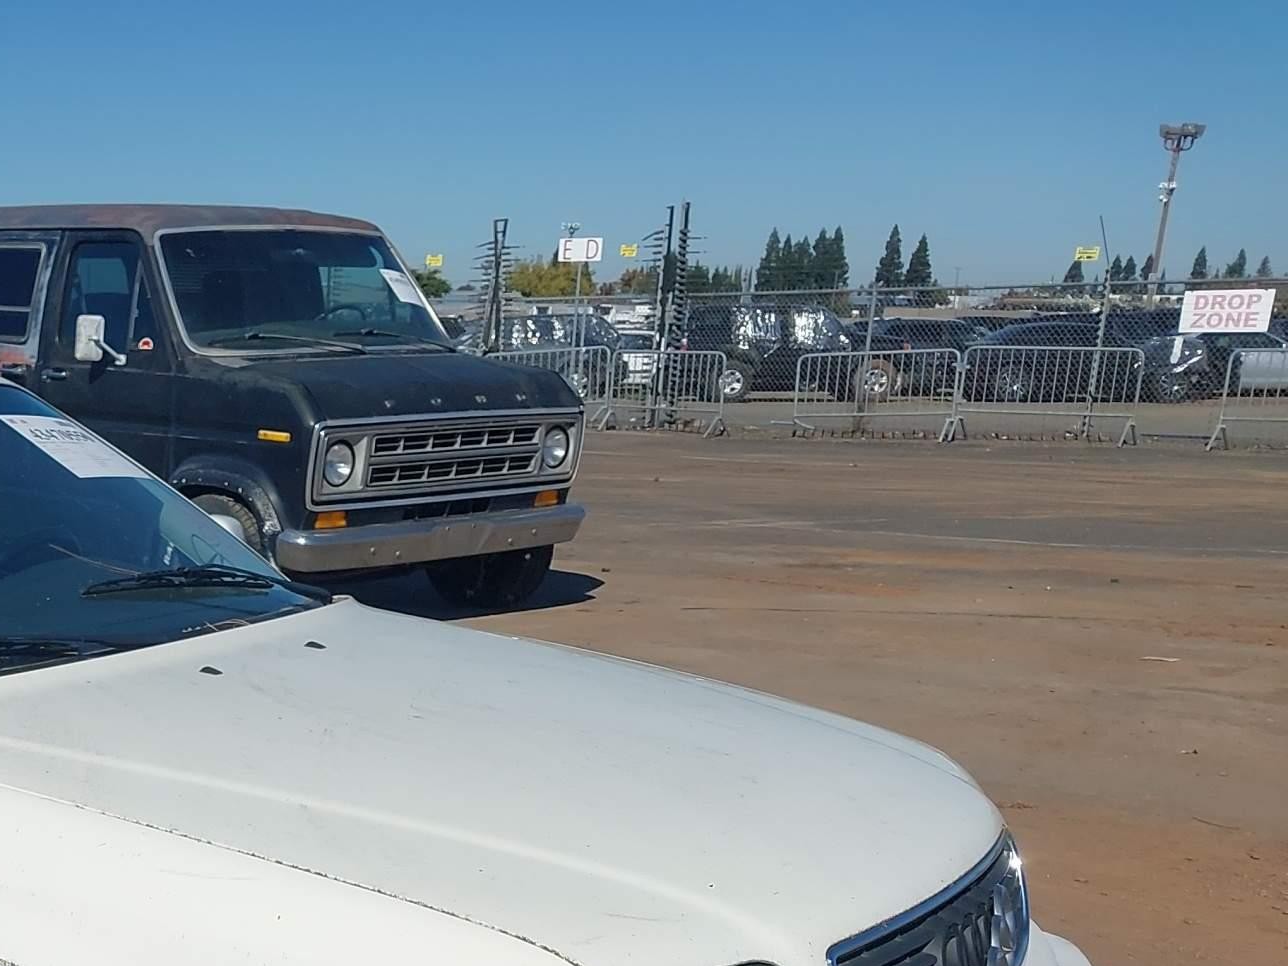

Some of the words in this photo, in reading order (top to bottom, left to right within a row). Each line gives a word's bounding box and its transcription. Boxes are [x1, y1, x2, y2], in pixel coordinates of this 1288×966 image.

[563, 240, 573, 260] E
[586, 239, 600, 259] D
[1193, 294, 1263, 311] DROP
[1190, 311, 1260, 329] ZONE
